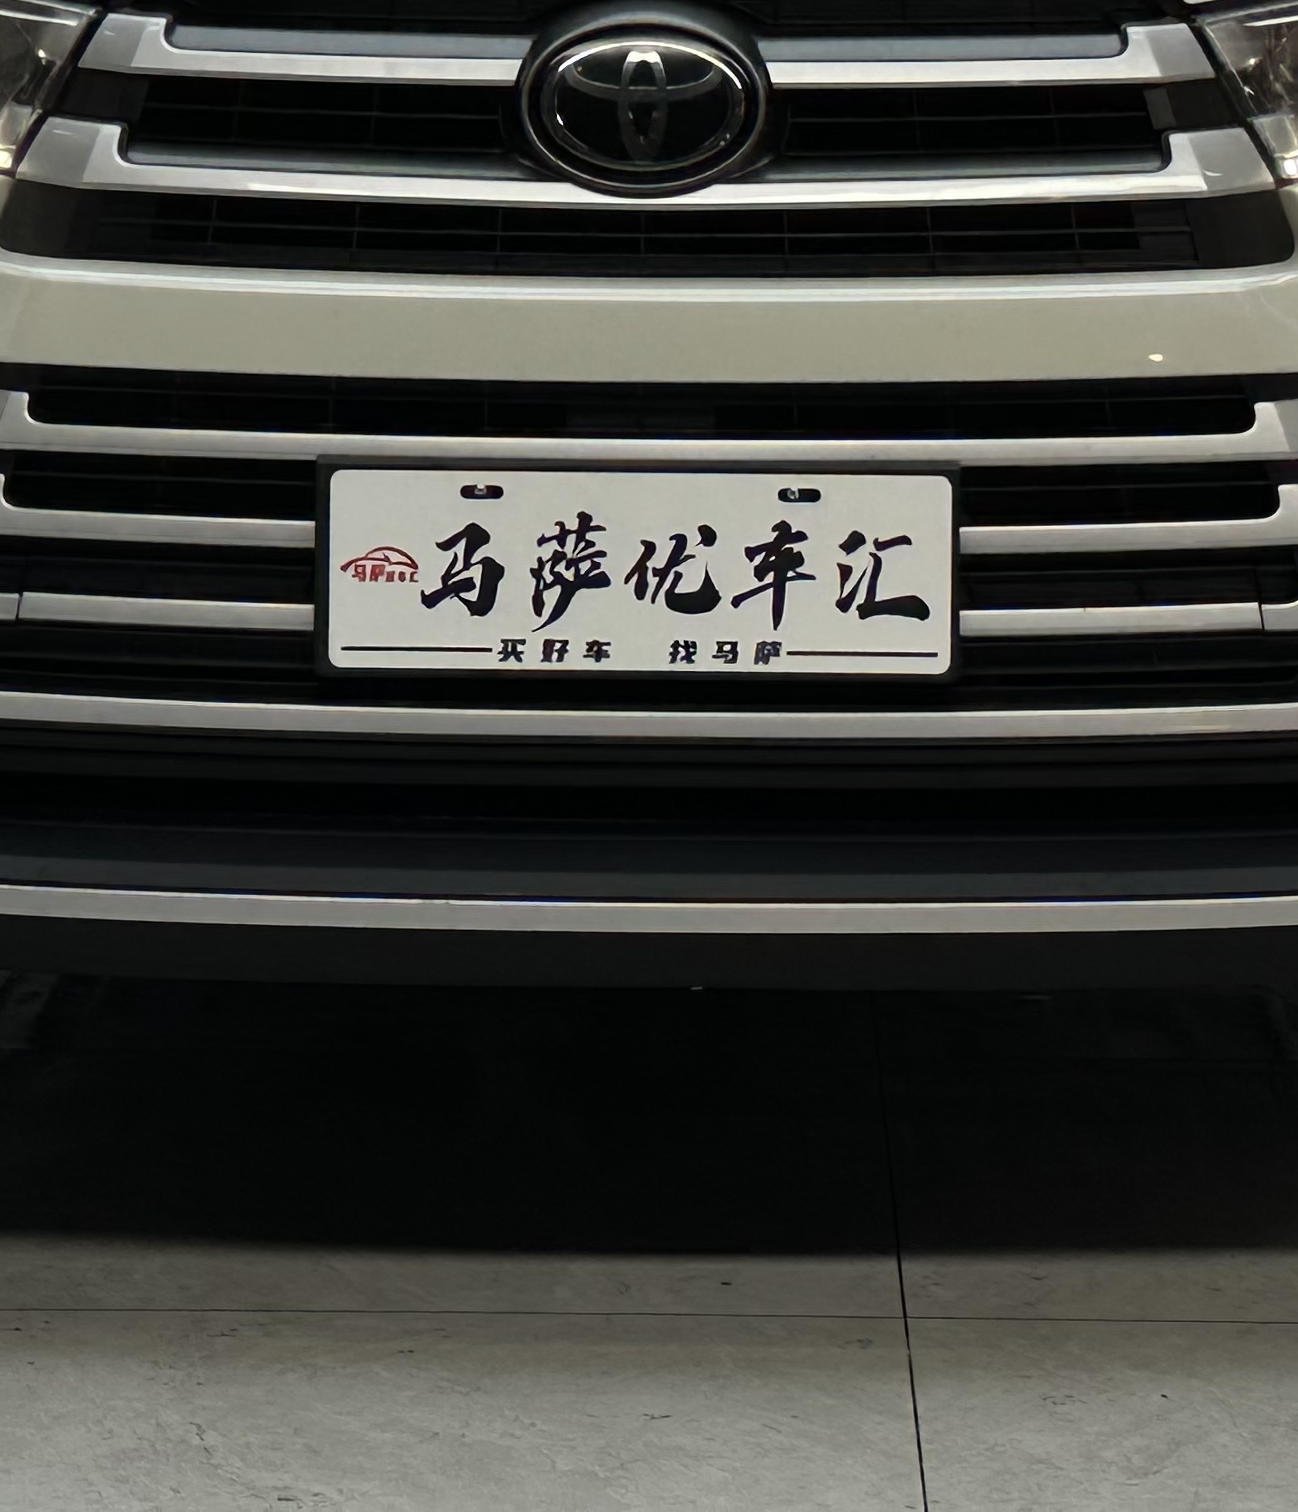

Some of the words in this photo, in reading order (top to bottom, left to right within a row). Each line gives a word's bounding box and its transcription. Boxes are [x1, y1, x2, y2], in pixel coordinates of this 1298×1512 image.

[420, 510, 931, 633] 马萨优车汇
[497, 638, 612, 664] 买好车
[668, 639, 783, 666] 找马萨
